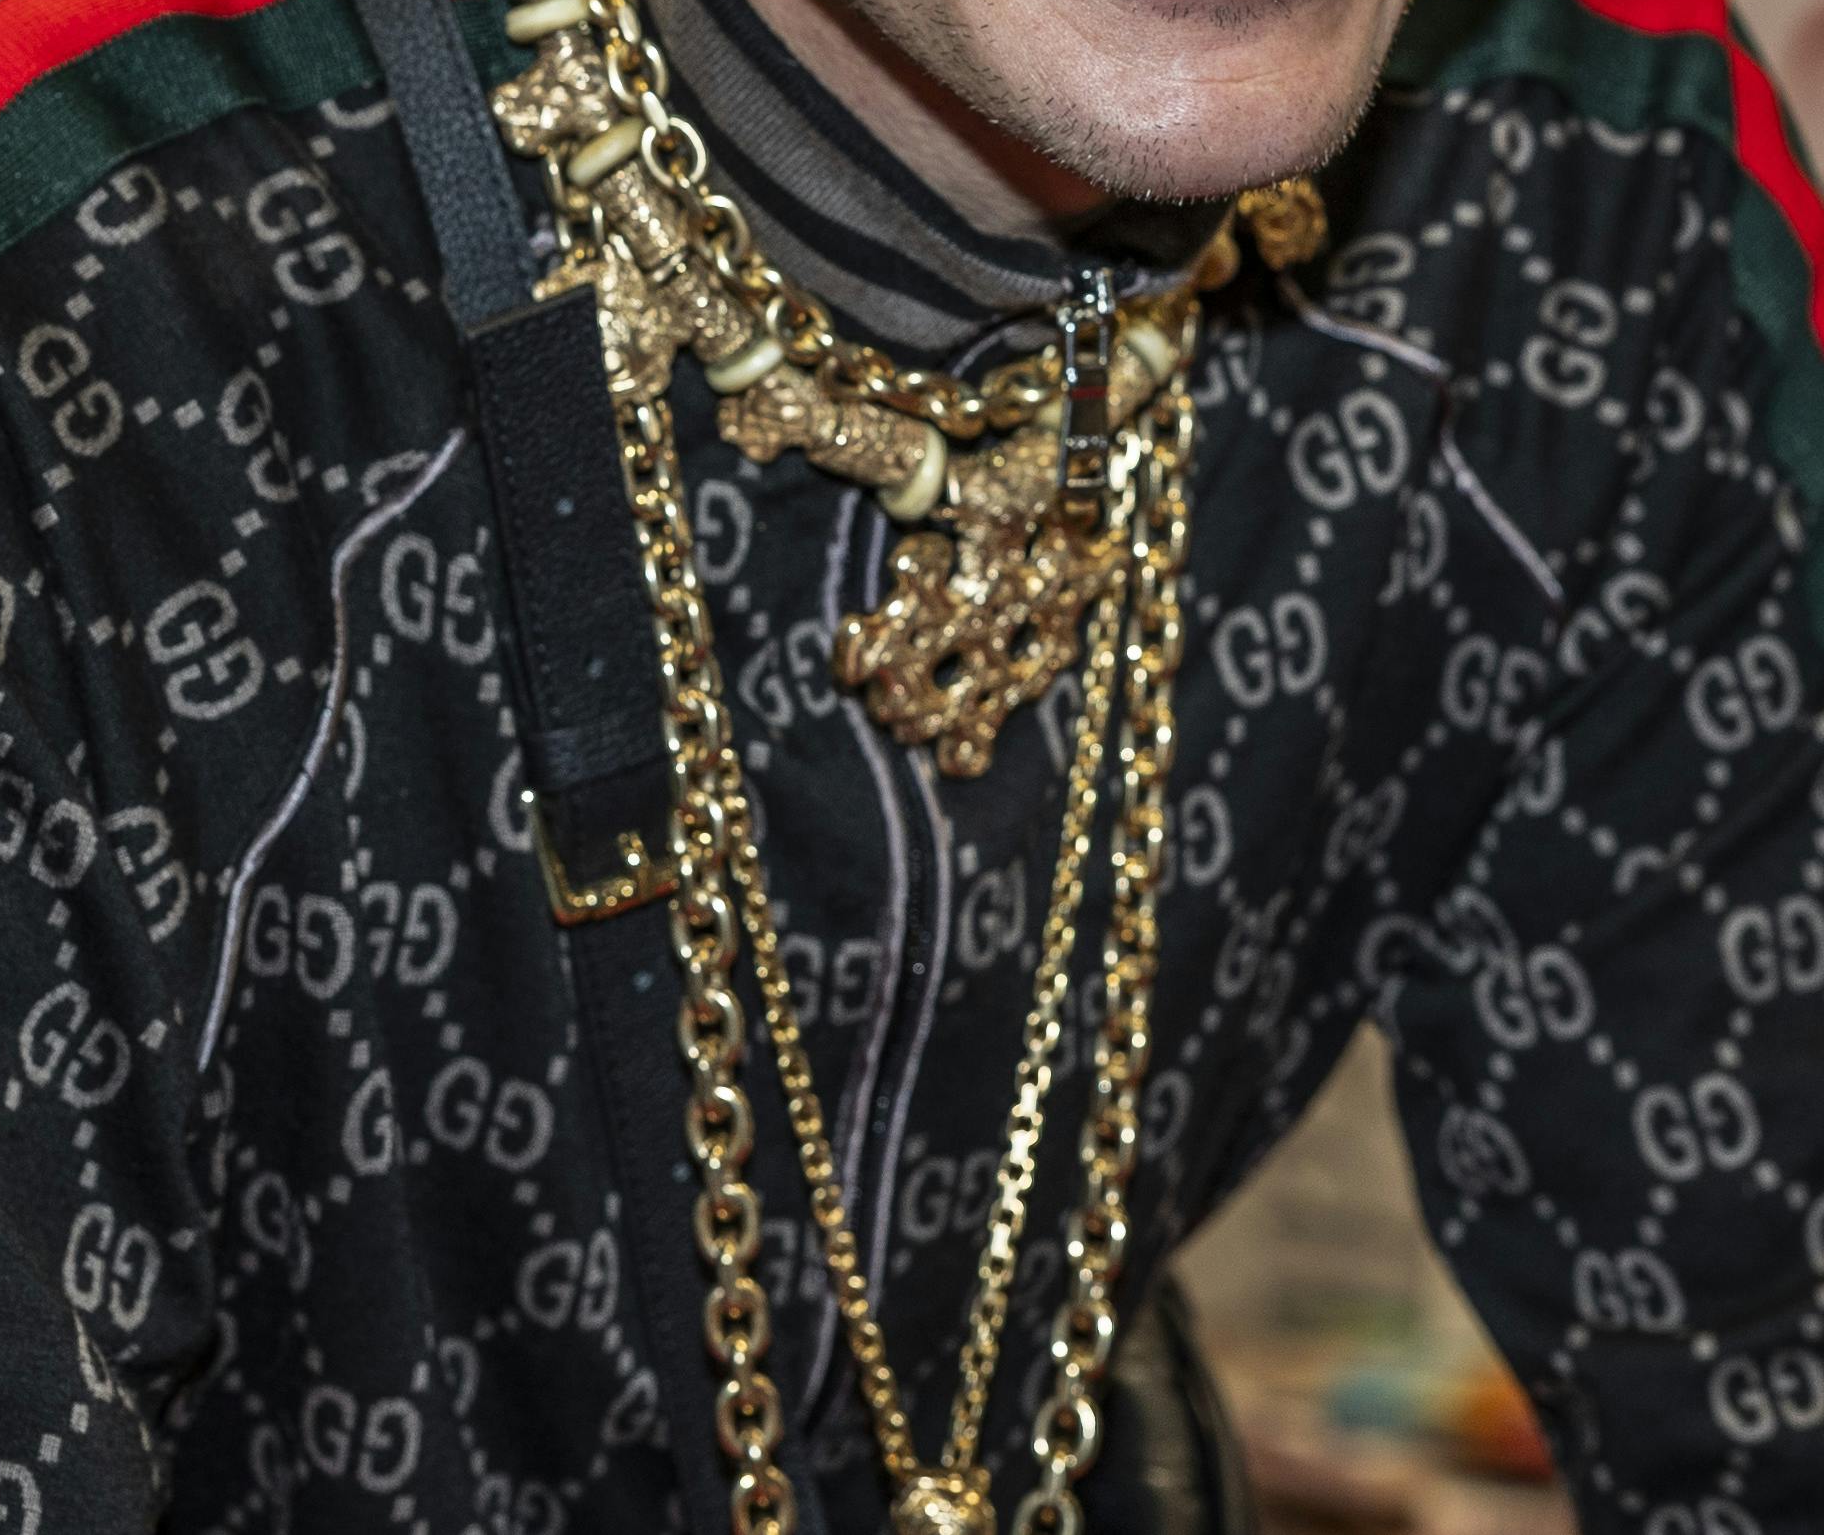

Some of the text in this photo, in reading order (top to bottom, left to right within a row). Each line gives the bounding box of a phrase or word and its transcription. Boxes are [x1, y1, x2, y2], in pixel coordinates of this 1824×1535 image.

[246, 166, 366, 306] GG
[18, 323, 124, 457] GG
[1287, 388, 1411, 511] GG
[143, 579, 265, 721] GG
[1211, 591, 1328, 708] GG
[1683, 633, 1803, 752] GG
[246, 882, 355, 1000] GG
[18, 979, 132, 1108] GG
[424, 1056, 555, 1172] GG
[1630, 1071, 1762, 1181] GG
[62, 1201, 162, 1332] GG
[302, 1384, 424, 1493] GG
